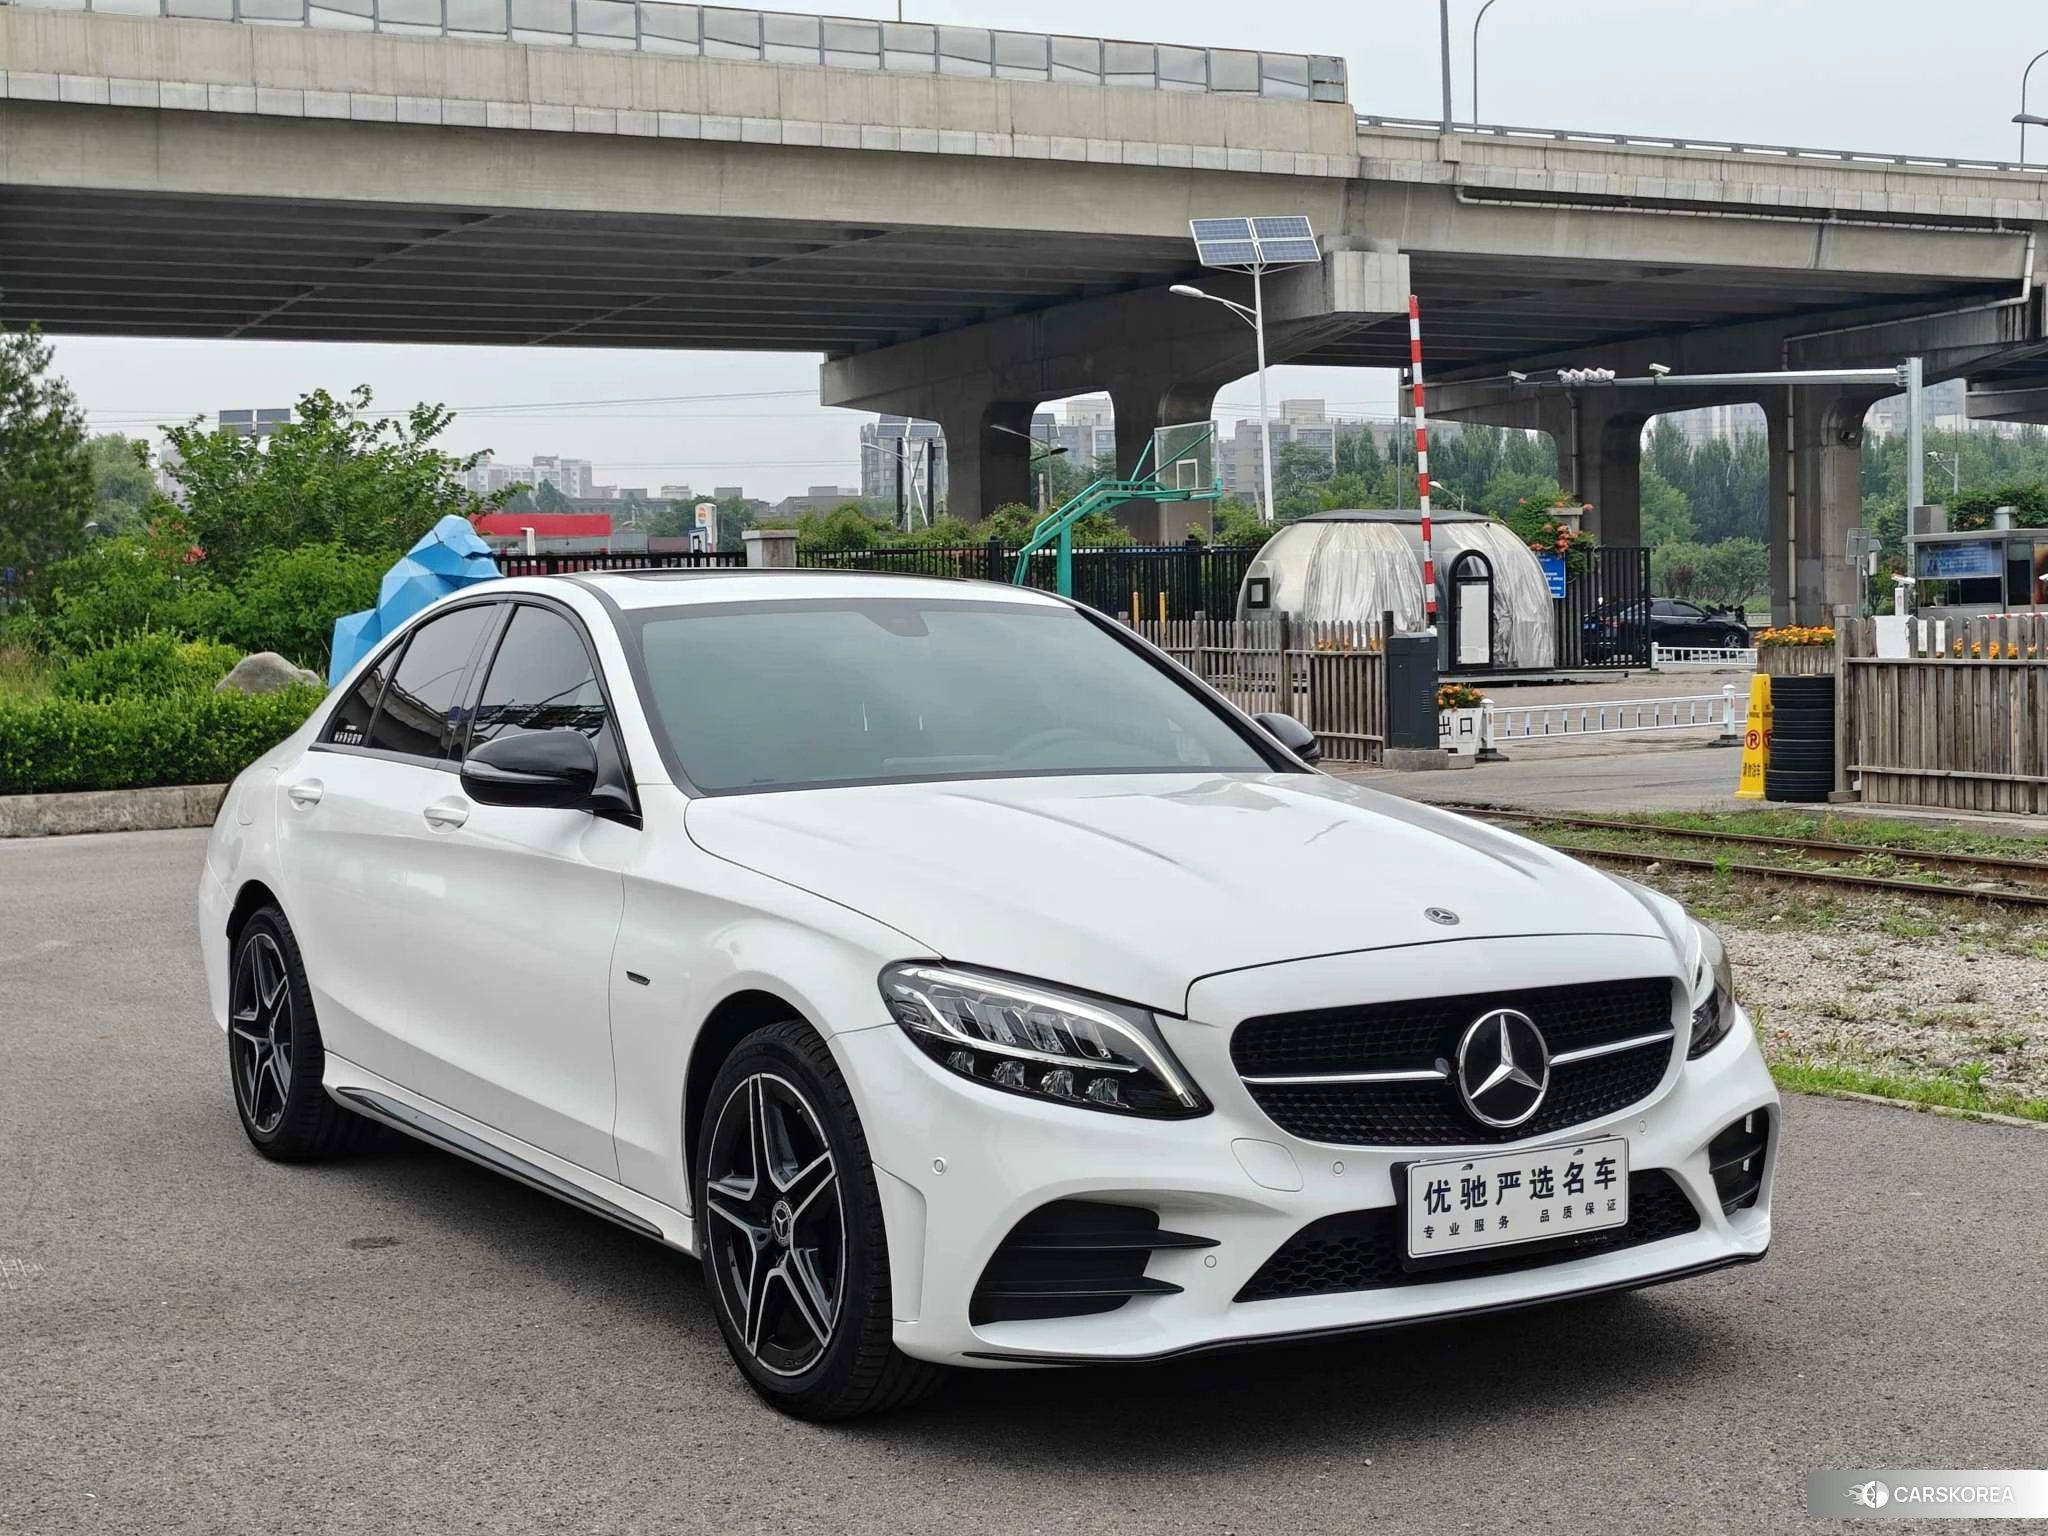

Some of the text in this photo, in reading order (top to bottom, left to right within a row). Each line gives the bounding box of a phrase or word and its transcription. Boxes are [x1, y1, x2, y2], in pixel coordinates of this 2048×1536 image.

[1438, 716, 1473, 736] 出口
[1423, 1157, 1617, 1216] 优驰严选名车
[1423, 1198, 1617, 1239] 专业服务 品质保证
